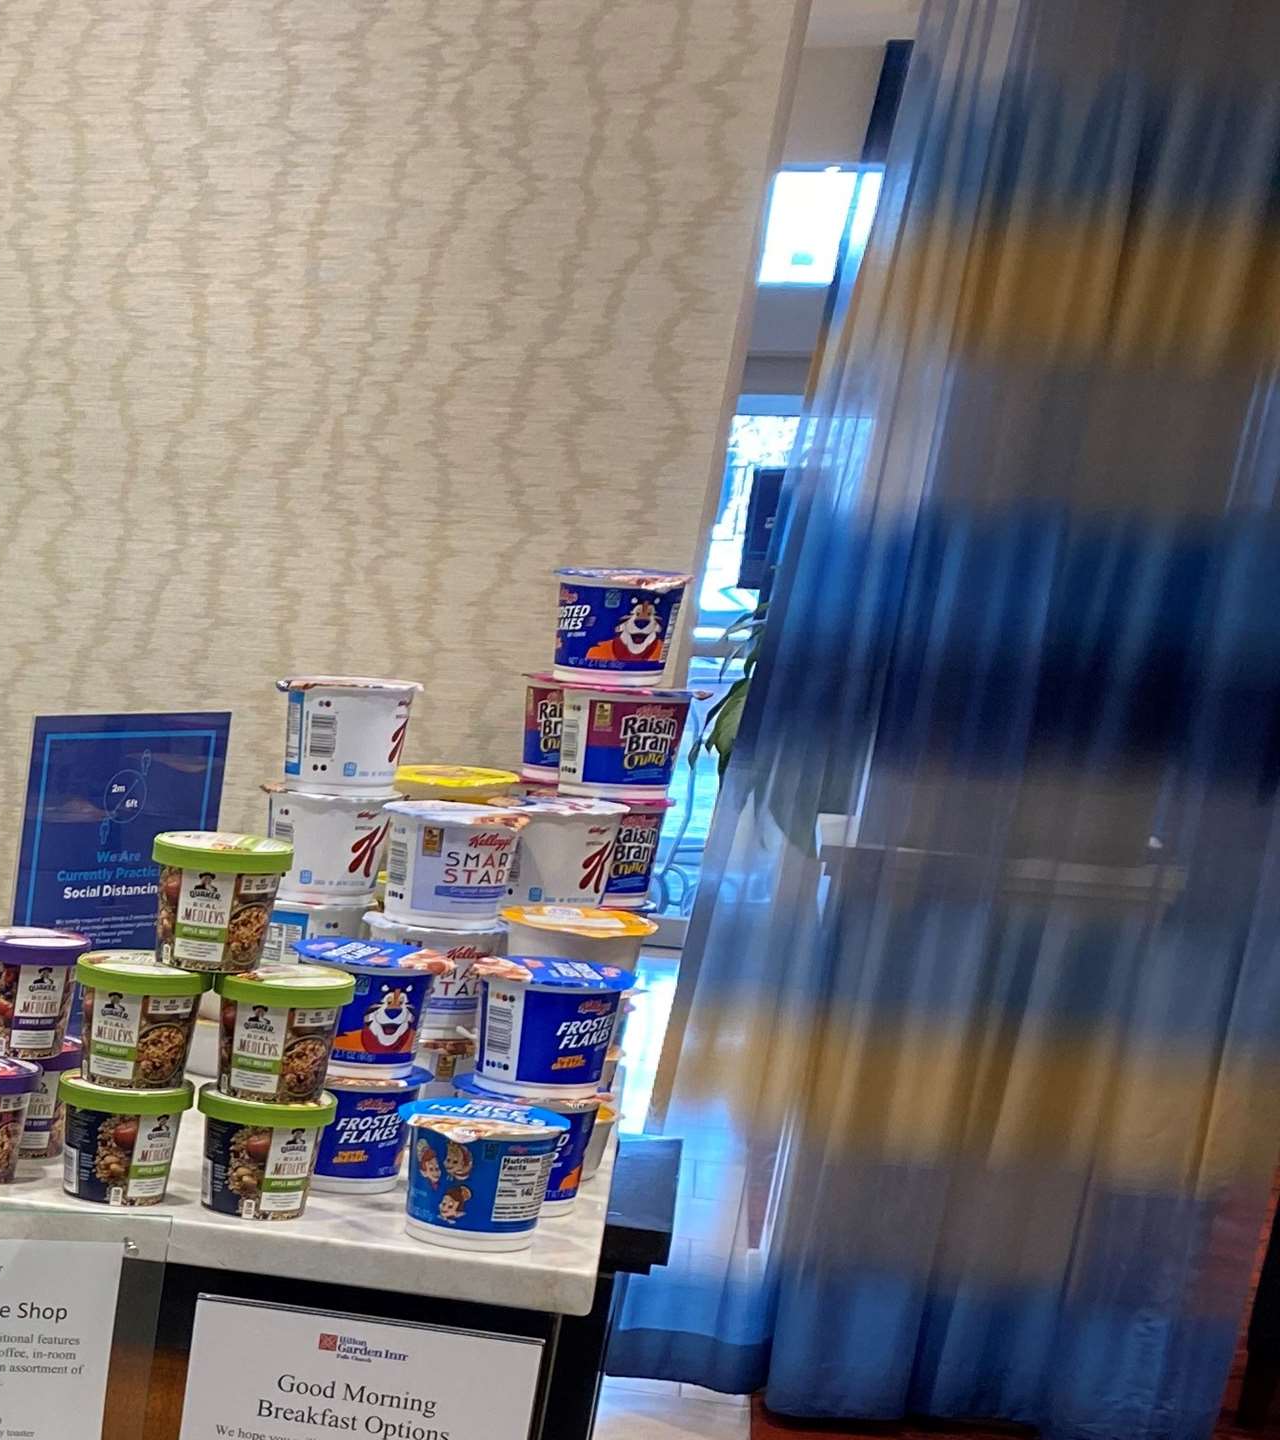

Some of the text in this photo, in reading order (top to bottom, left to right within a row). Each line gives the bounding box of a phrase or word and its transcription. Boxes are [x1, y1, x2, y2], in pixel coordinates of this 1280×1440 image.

[624, 716, 676, 738] Raisin
[625, 735, 669, 753] Bran
[112, 784, 126, 793] 2m
[126, 799, 138, 808] 6ft
[96, 851, 140, 863] We Are
[57, 867, 159, 882] Currently Practic
[64, 884, 158, 899] Social Distancin
[181, 908, 225, 925] MEDLEYS
[559, 1034, 610, 1050] FLAKES
[336, 1113, 401, 1132] FROSTED
[339, 1125, 399, 1144] FLAKES
[503, 1157, 540, 1165] Nutrition
[17, 1302, 68, 1323] Shop
[38, 1334, 80, 1346] features
[32, 1348, 76, 1360] in-room
[9, 1362, 68, 1374] assortment
[71, 1363, 85, 1374] of
[277, 1374, 437, 1418] Good Morning
[256, 1399, 357, 1431] Breakfast
[216, 1424, 235, 1437] We
